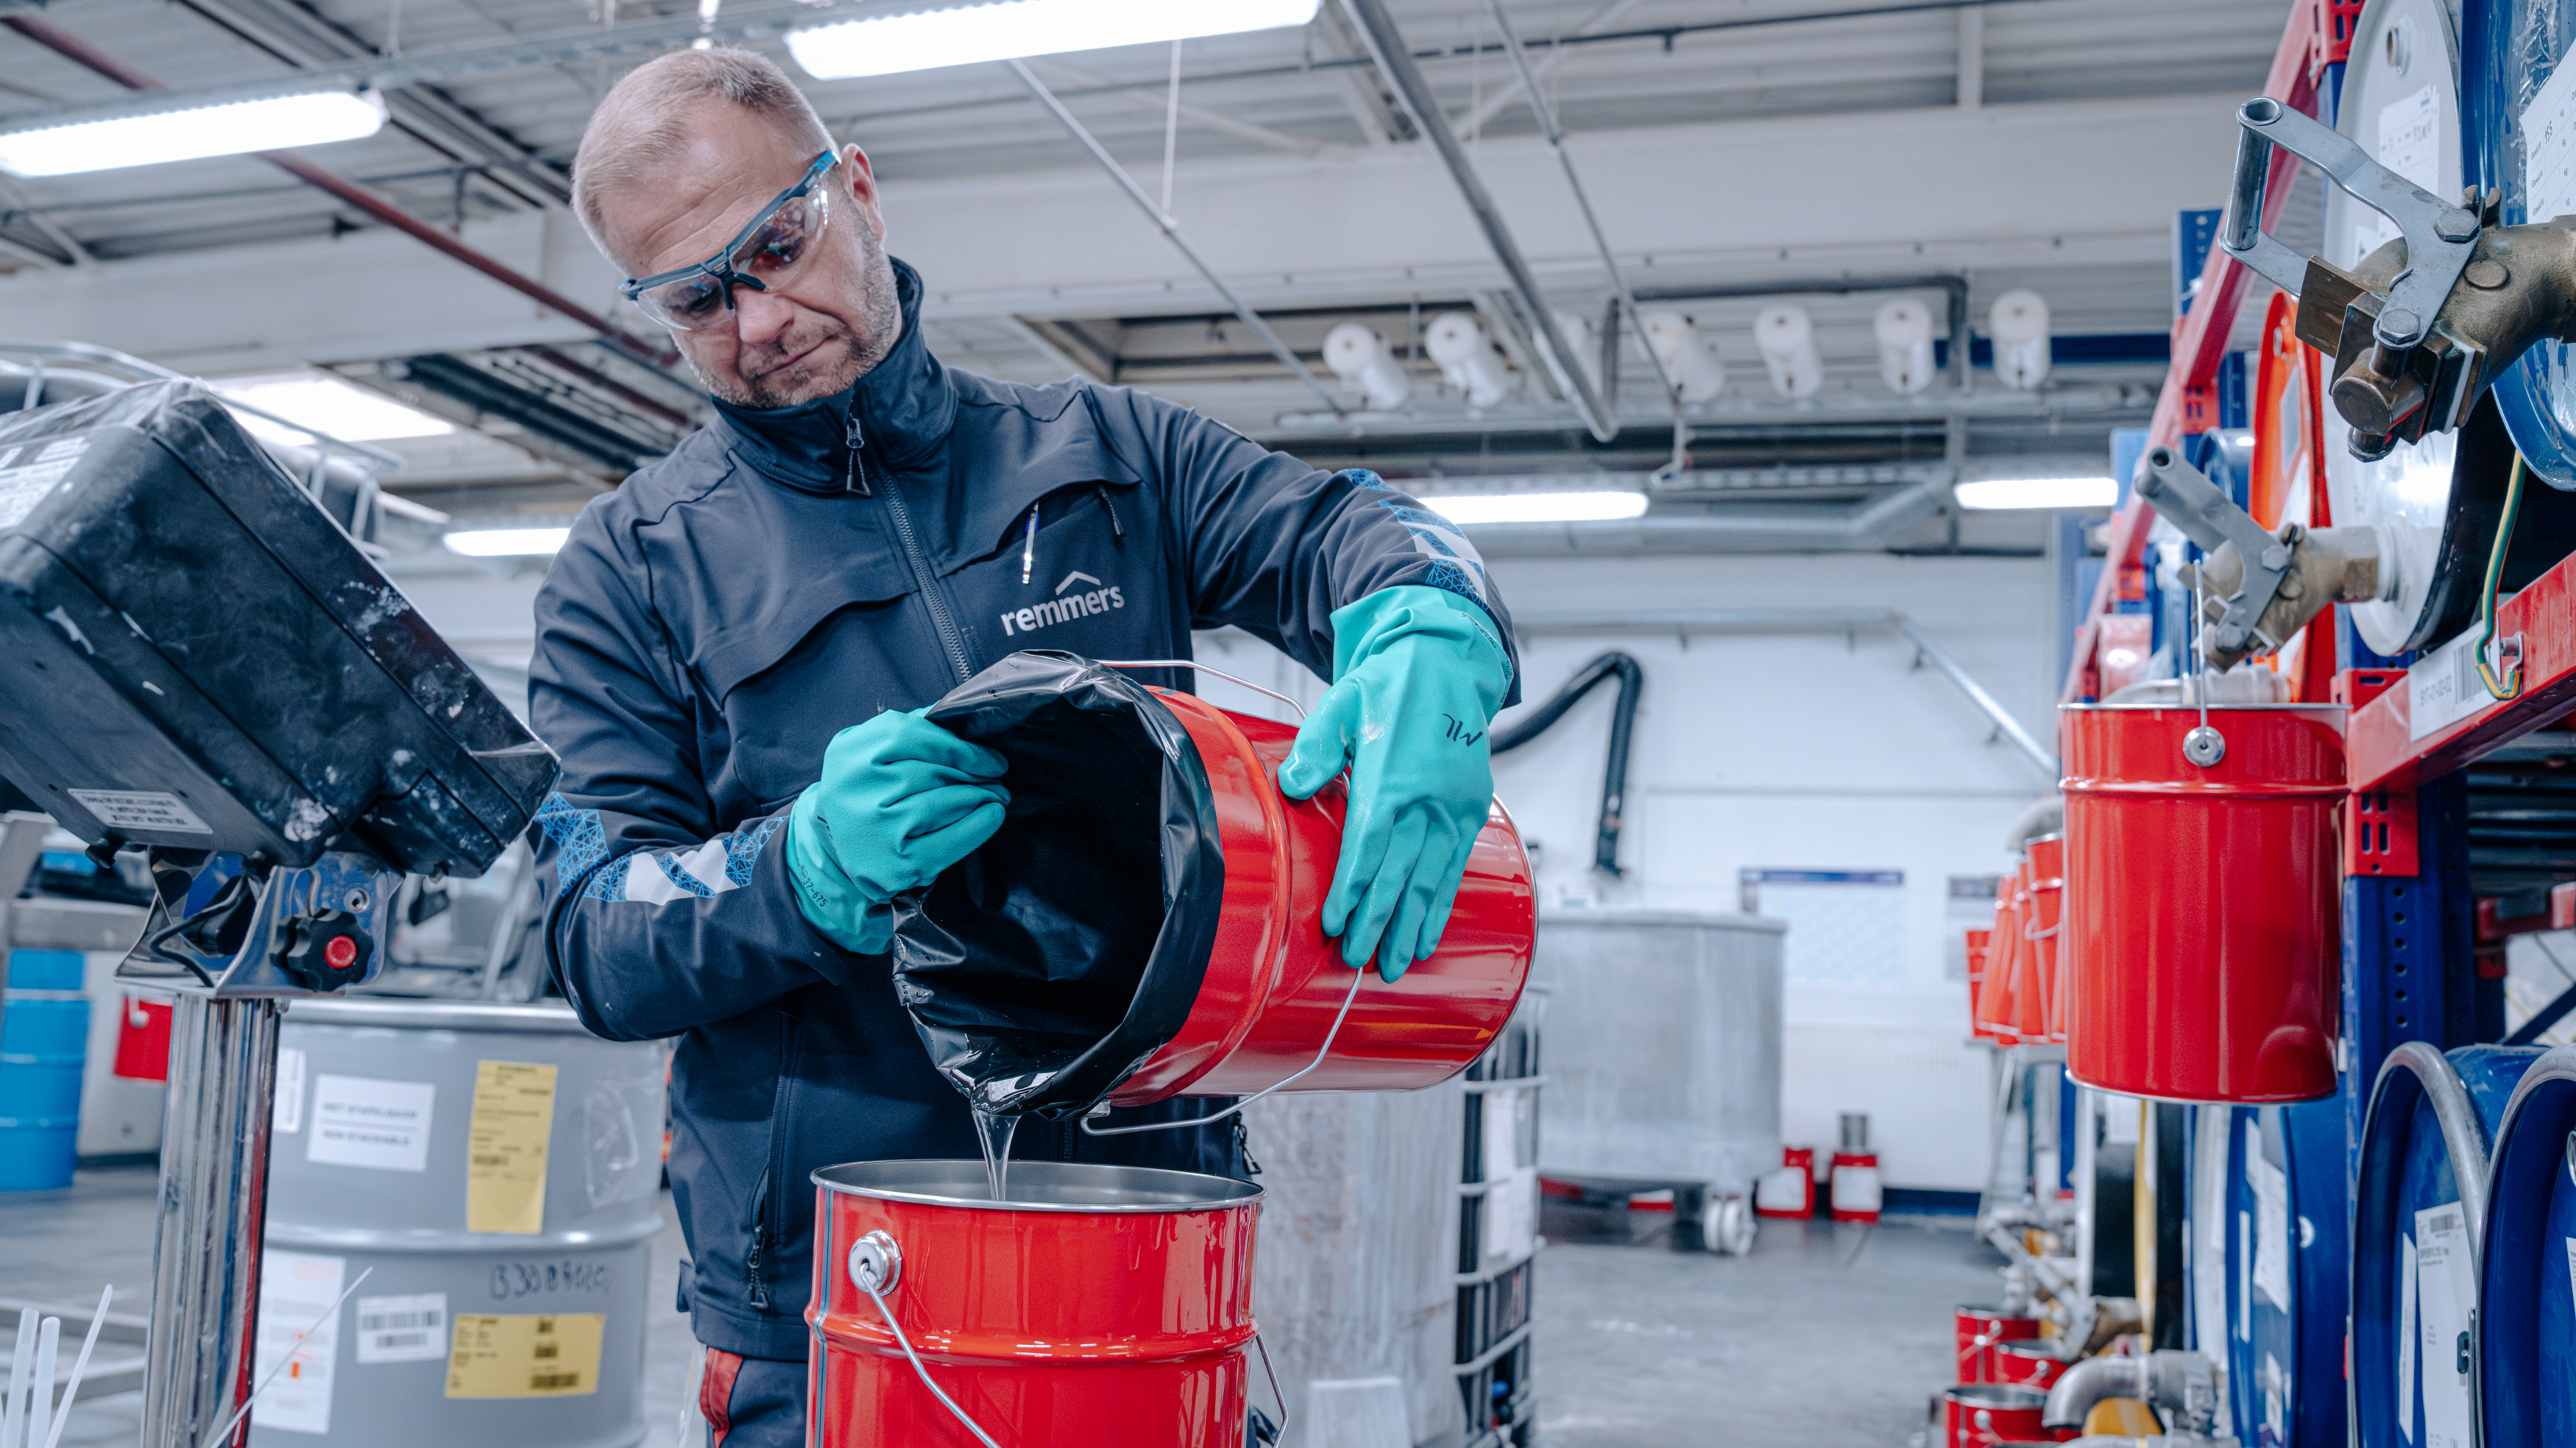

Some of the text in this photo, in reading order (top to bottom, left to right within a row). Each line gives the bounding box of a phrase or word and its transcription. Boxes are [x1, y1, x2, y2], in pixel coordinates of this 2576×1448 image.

[2530, 141, 2541, 160] Gewicht
[2532, 169, 2543, 188] Gewicht
[2533, 197, 2544, 216] Gewicht
[1000, 586, 1125, 636] remmers
[803, 878, 827, 906] 37-675
